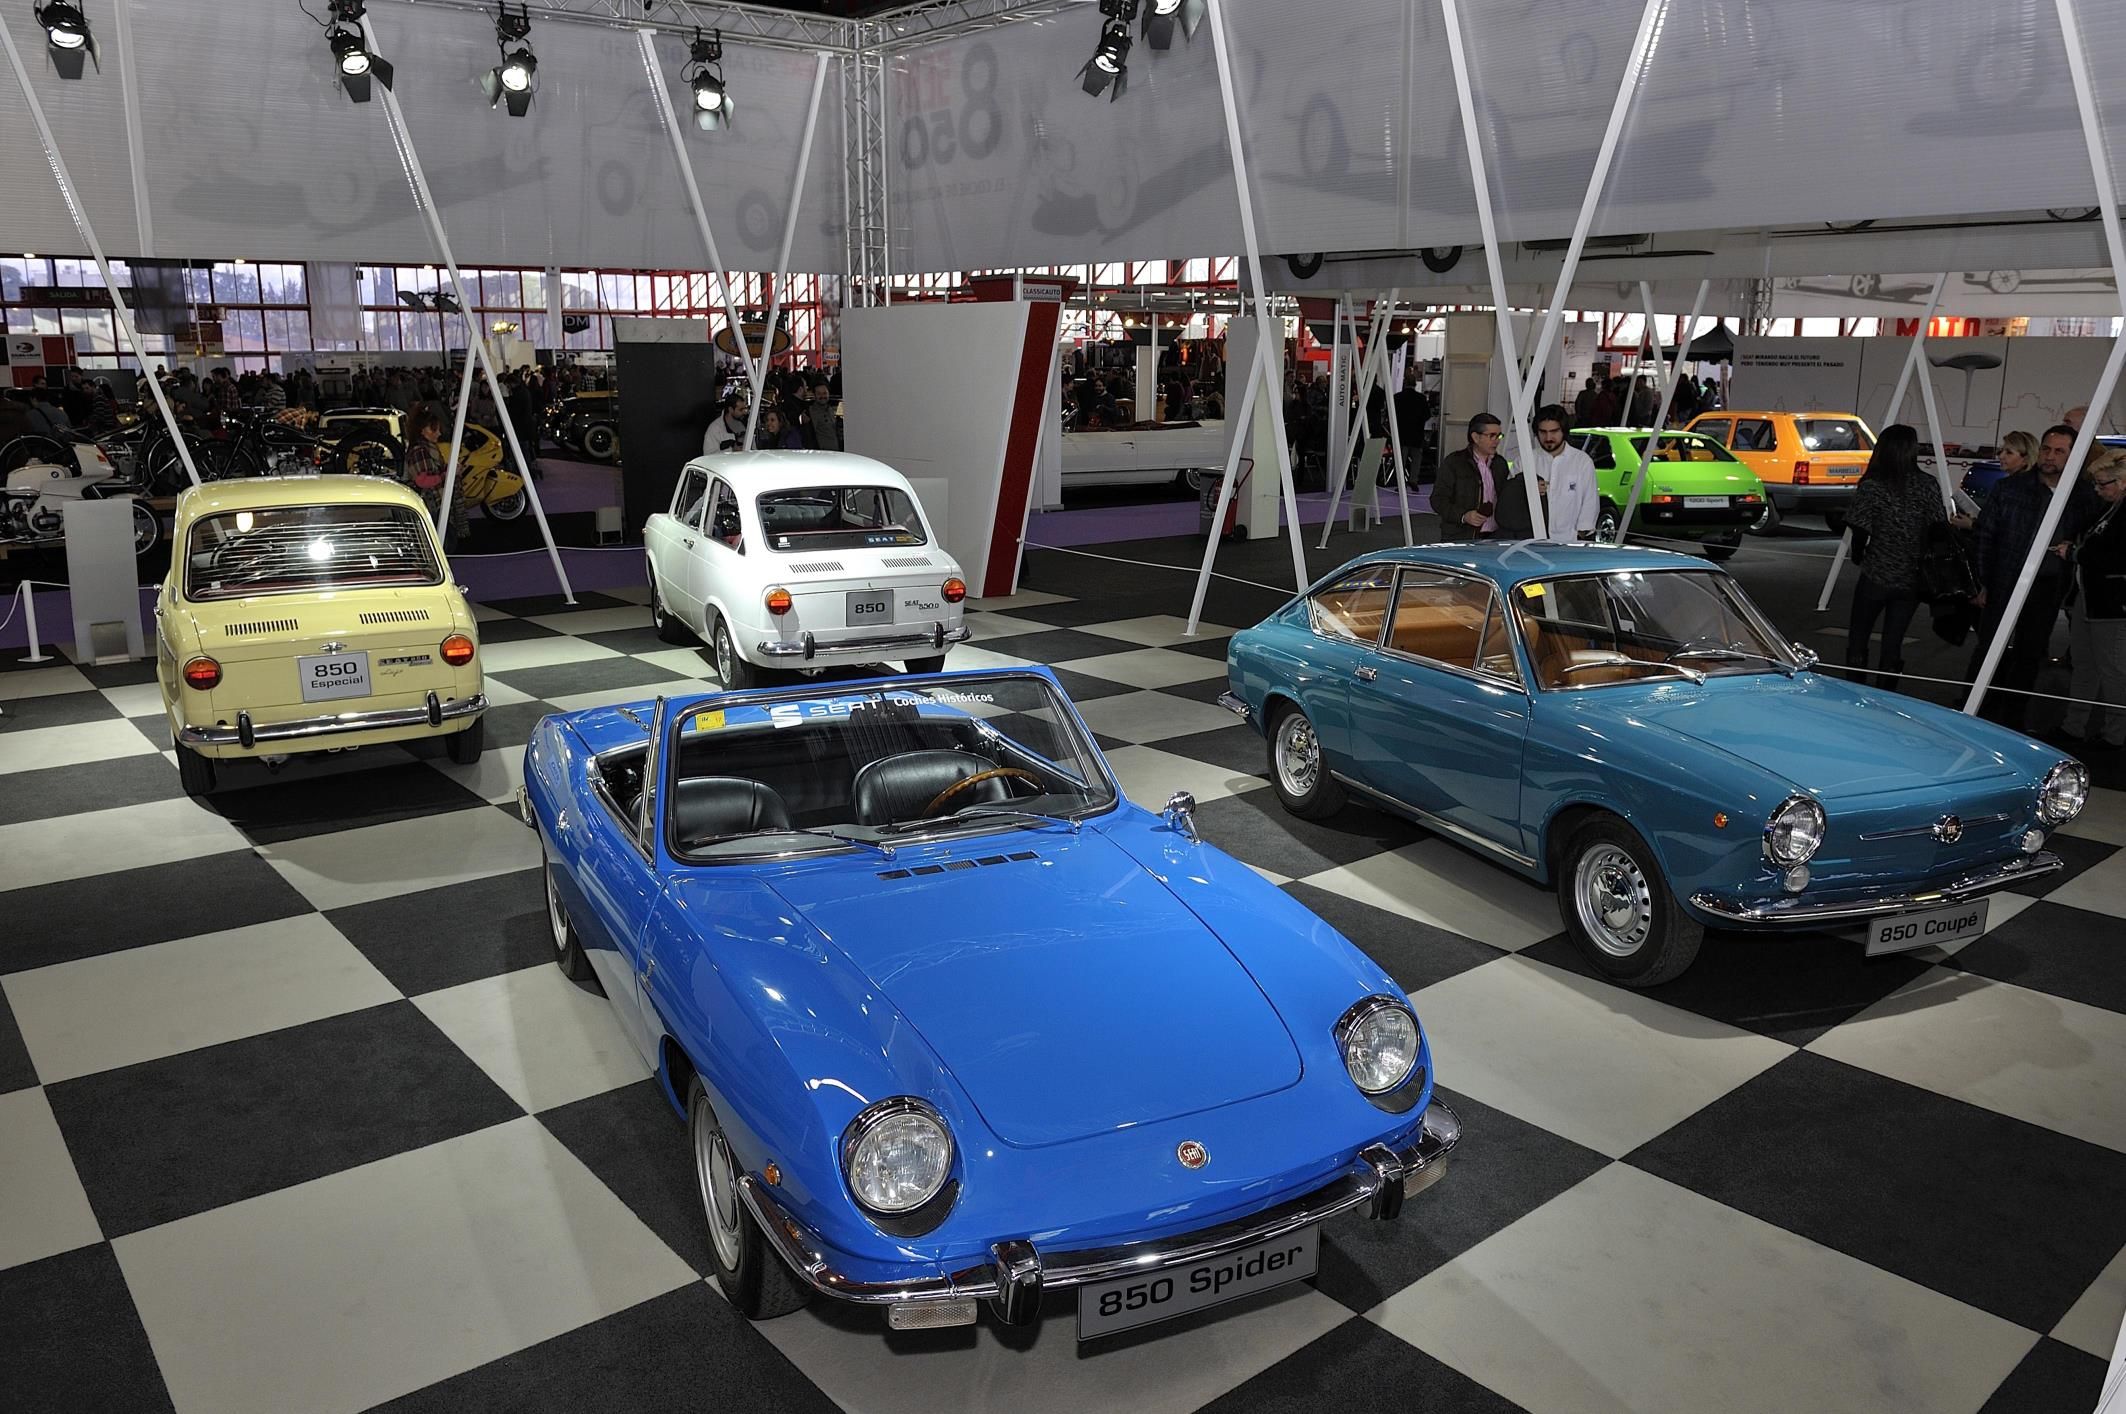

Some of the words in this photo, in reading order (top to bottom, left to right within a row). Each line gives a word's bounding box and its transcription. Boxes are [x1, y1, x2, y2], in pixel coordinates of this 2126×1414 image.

[49, 290, 80, 299] SALIDA
[1022, 286, 1061, 296] CLASSICAUTO
[1828, 467, 1860, 475] MARBELLA
[1706, 496, 1724, 505] Sport
[868, 536, 895, 544] SEAT
[855, 602, 885, 614] 850
[314, 661, 358, 678] 850
[311, 675, 363, 689] Especial
[809, 698, 880, 717] SEAT
[893, 695, 937, 709] Coches
[937, 690, 995, 705] Históricos
[1879, 923, 1919, 944] 850
[1924, 911, 1978, 934] Coupé
[1183, 1148, 1202, 1161] SEAT
[1099, 1277, 1175, 1318] 850
[1189, 1246, 1303, 1293] Spider
